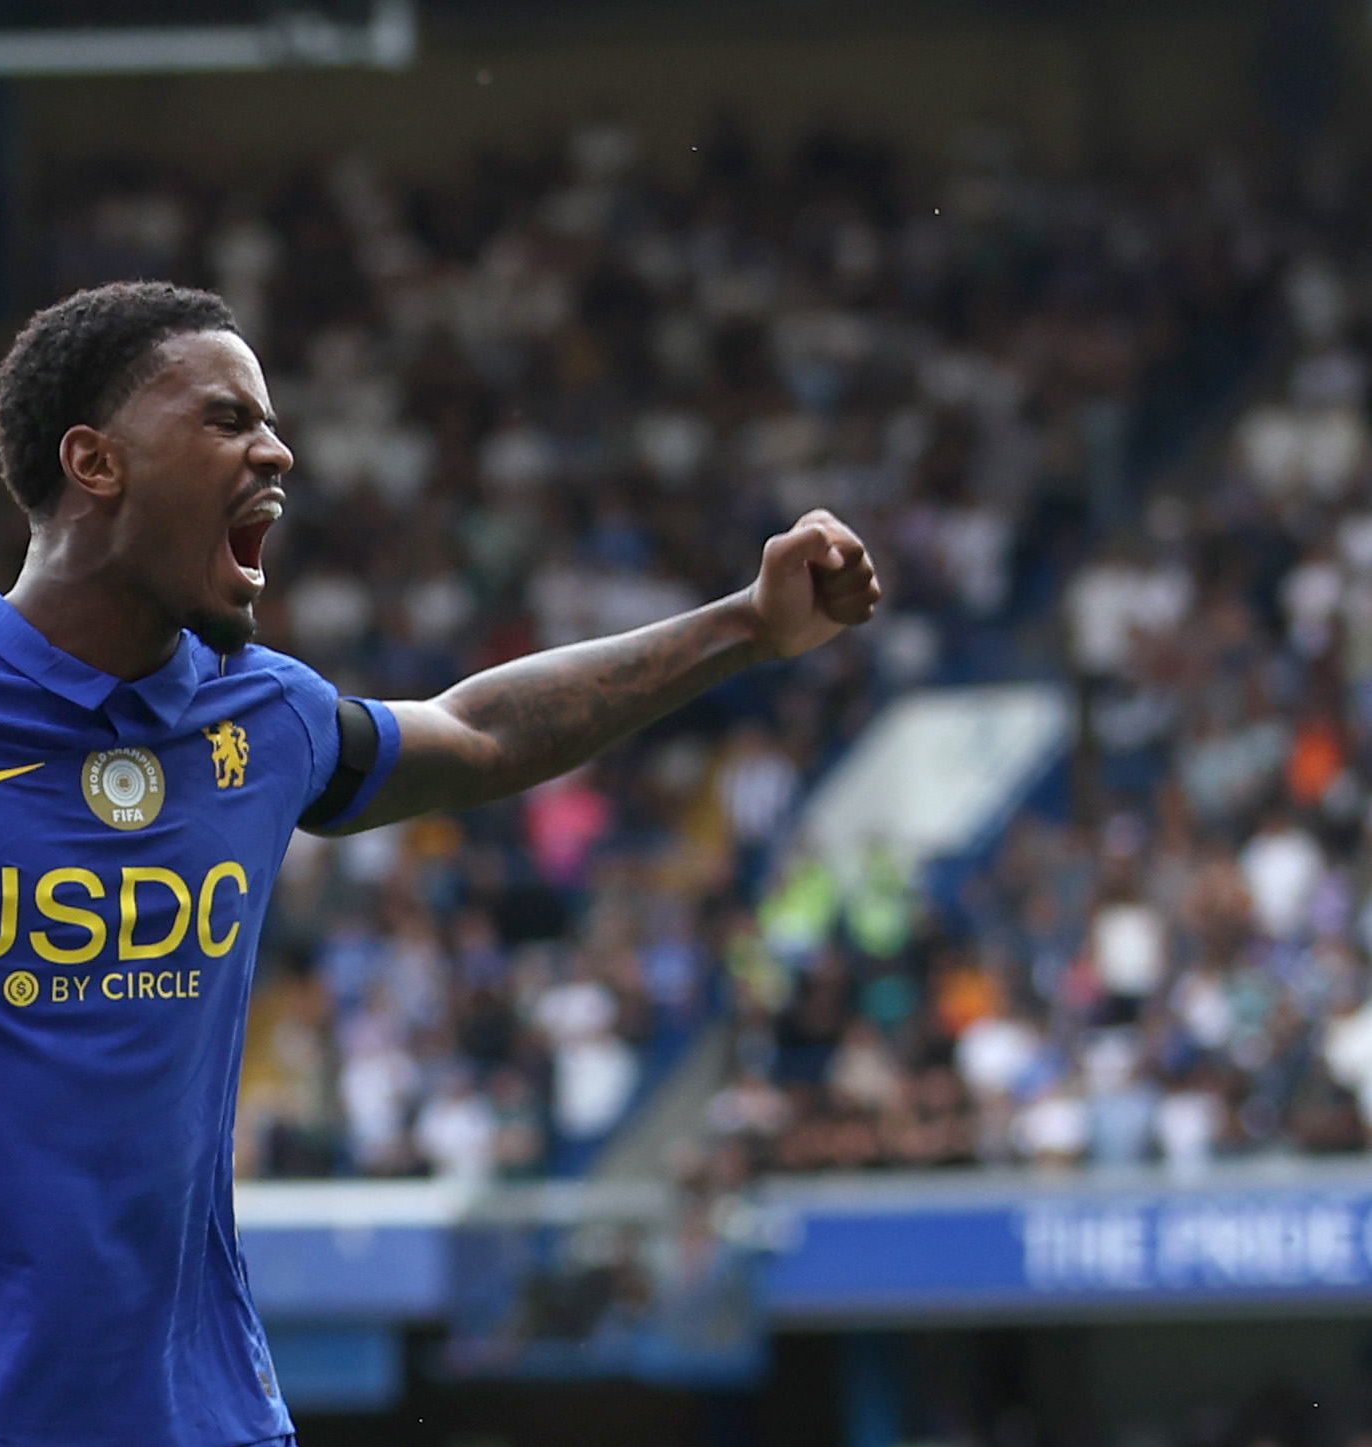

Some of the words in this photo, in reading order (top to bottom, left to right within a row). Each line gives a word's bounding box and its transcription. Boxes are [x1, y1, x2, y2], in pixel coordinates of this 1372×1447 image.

[89, 753, 107, 796] WORLD
[112, 808, 145, 823] FIFA
[51, 975, 91, 1002] BY
[101, 970, 201, 1000] CIRCLE
